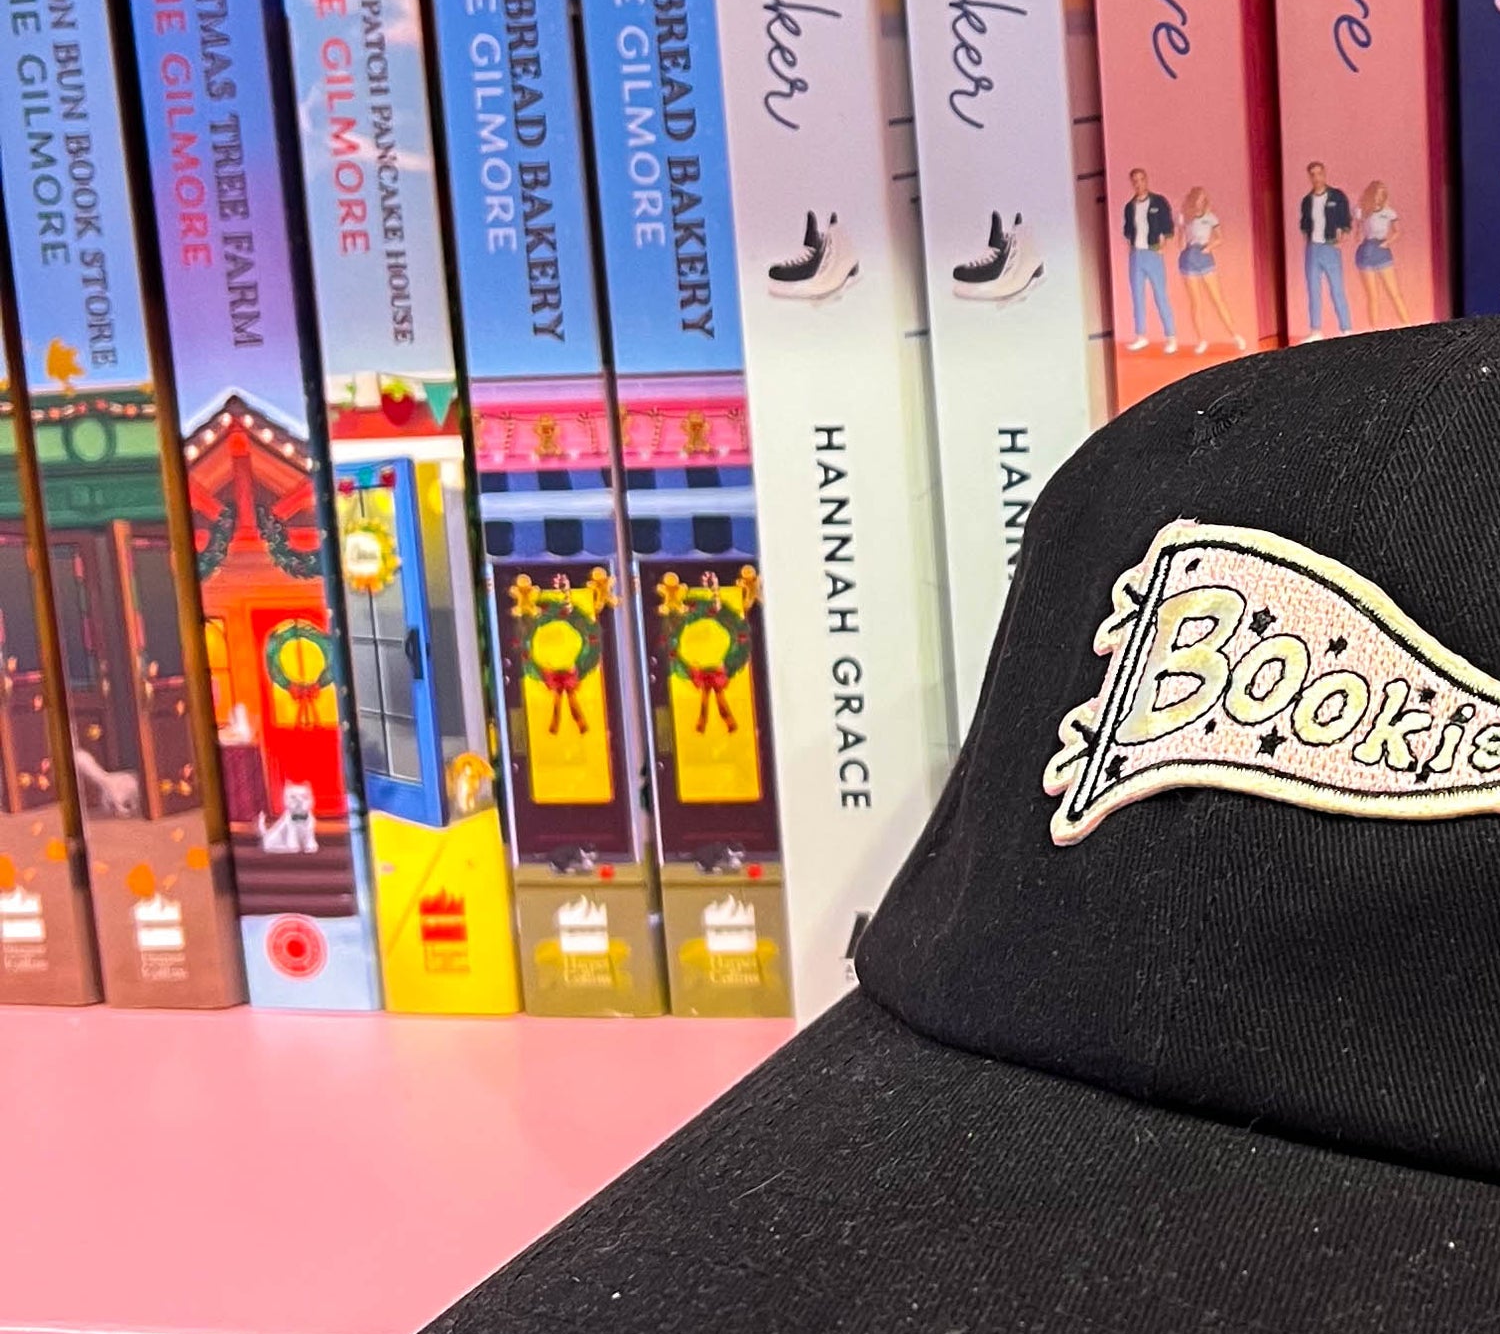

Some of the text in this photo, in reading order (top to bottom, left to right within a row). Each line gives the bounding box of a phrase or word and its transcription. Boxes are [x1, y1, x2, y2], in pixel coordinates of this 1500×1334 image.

[52, 43, 88, 123] BUN
[361, 0, 390, 96] PATCH
[17, 54, 71, 267] GILMORE
[64, 134, 101, 239] BOOK
[160, 51, 212, 269] GILMORE
[209, 112, 250, 220] TREE
[321, 36, 371, 254] GILMORE
[371, 105, 405, 245] PANCAKE
[467, 32, 517, 254] GILMORE
[616, 24, 666, 249] GILMORE
[79, 250, 119, 369] STORE
[220, 232, 264, 349] FARM
[384, 250, 415, 346] HOUSE
[518, 160, 566, 343] BAKERY
[667, 155, 715, 340] BAKERY
[813, 423, 873, 811] HANNAH GRACE
